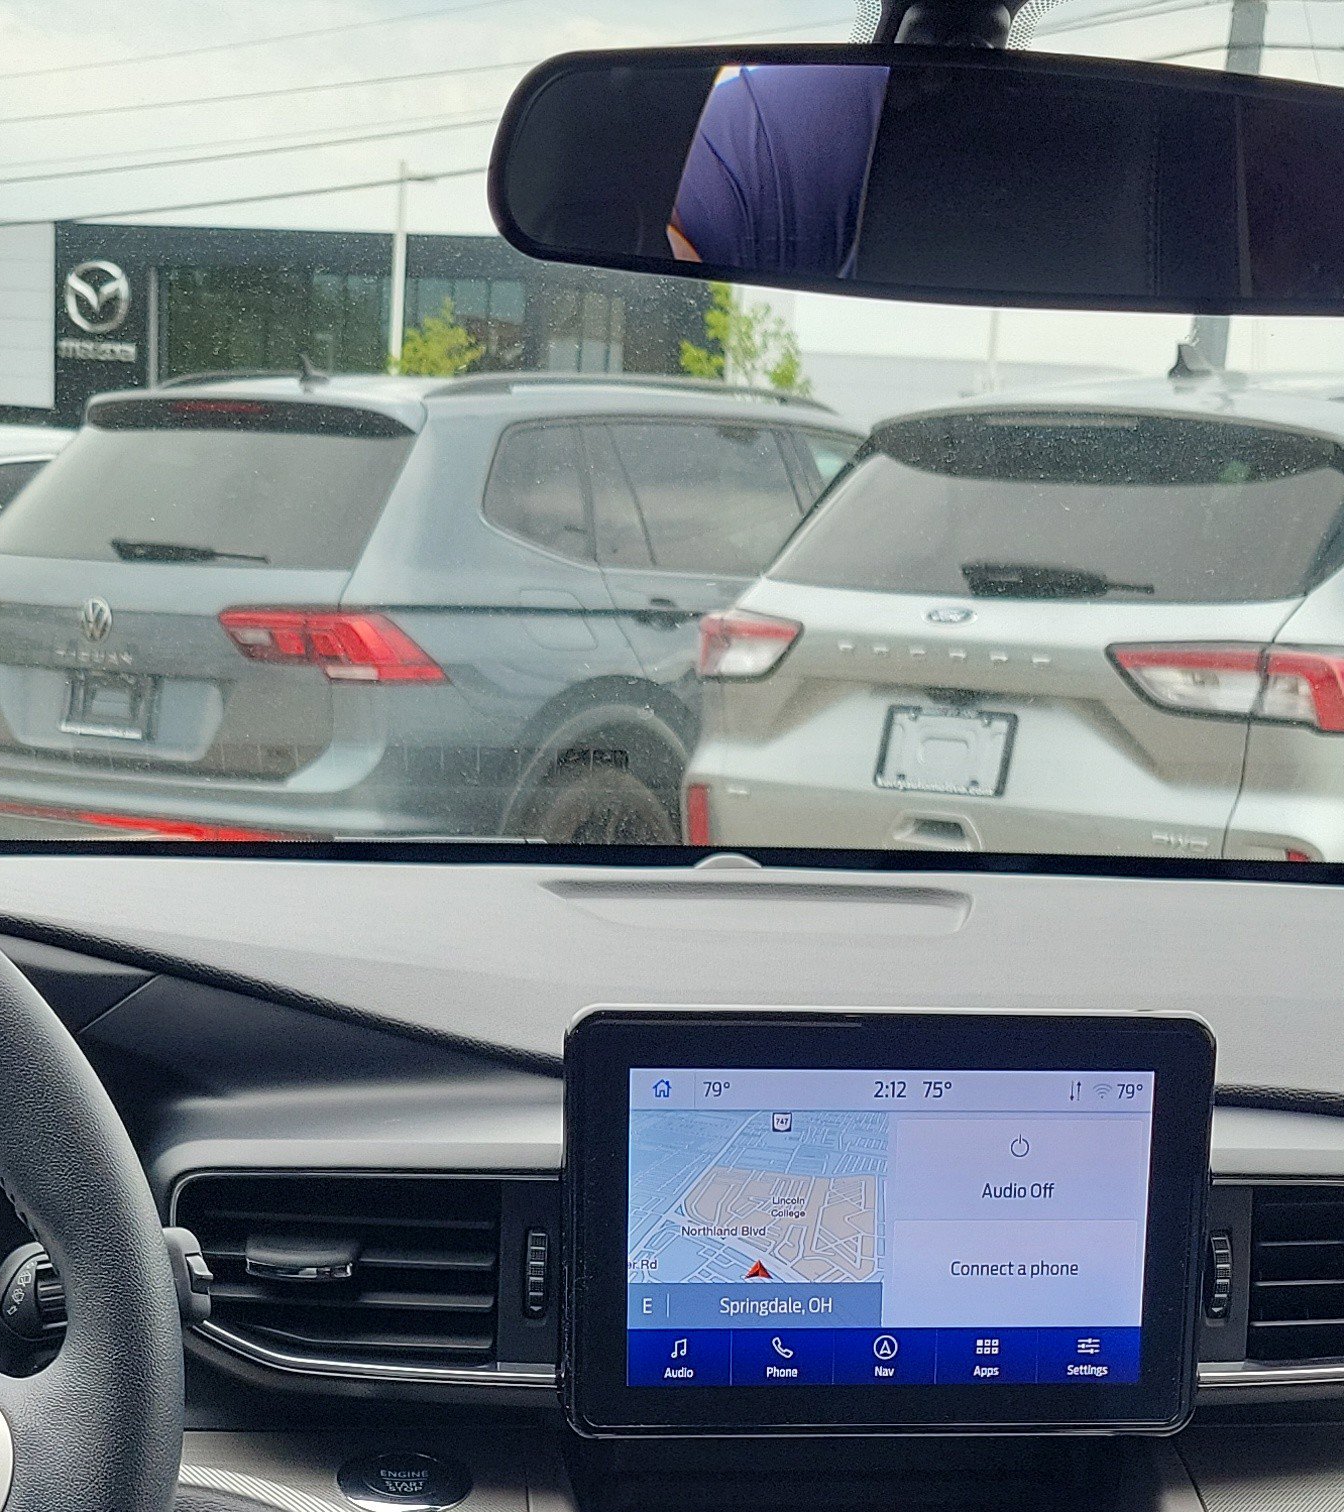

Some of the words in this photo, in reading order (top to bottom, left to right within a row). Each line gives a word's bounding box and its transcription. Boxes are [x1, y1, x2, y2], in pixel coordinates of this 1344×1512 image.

[873, 1081, 907, 1098] 2:12
[982, 1183, 1027, 1198] Audio
[1030, 1183, 1055, 1198] Off
[772, 1196, 805, 1205] Lincoln
[771, 1209, 806, 1219] College
[681, 1226, 738, 1237] Northland
[741, 1226, 766, 1237] Blvd
[640, 1259, 658, 1270] Rd
[950, 1261, 1015, 1276] Connect
[1017, 1263, 1027, 1276] a
[1030, 1260, 1079, 1278] phone
[642, 1298, 653, 1314] E
[719, 1298, 806, 1316] Springdale,
[808, 1297, 833, 1313] OH
[664, 1367, 694, 1379] Audio
[766, 1366, 798, 1378] Phone
[874, 1366, 895, 1377] Nav
[973, 1366, 1000, 1377] Apps
[1067, 1365, 1108, 1376] Settings
[380, 1469, 429, 1478] ENGINE
[385, 1480, 424, 1488] START
